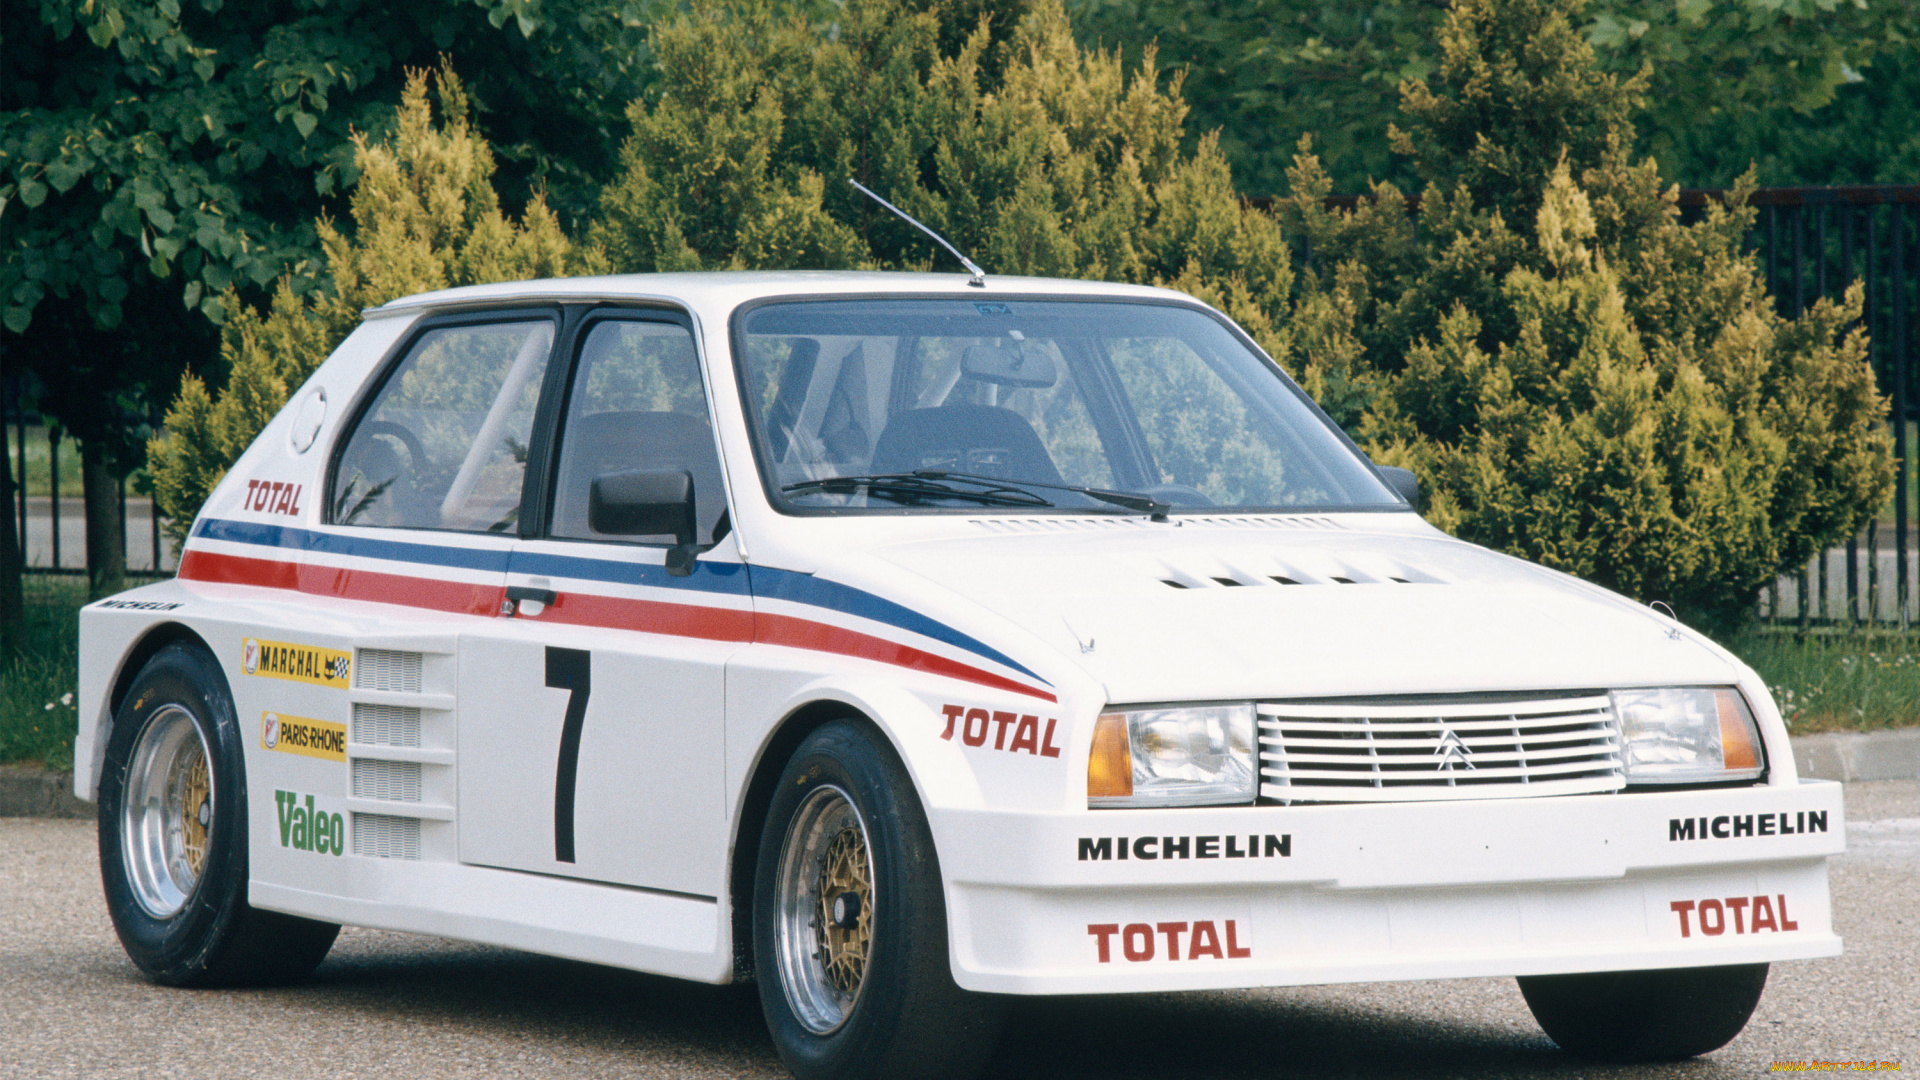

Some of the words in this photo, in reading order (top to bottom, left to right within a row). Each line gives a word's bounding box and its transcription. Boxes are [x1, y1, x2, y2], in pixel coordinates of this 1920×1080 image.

[244, 479, 303, 516] TOTAL
[95, 599, 184, 611] MICHELIN
[259, 645, 322, 679] MARCHAL
[940, 704, 1061, 758] TOTAL
[544, 647, 591, 863] 7
[275, 789, 345, 857] Valeo
[1669, 810, 1828, 842] MICHELIN
[1077, 834, 1292, 861] MICHELIN
[1670, 894, 1799, 938] TOTAL
[1087, 919, 1251, 963] TOTAL
